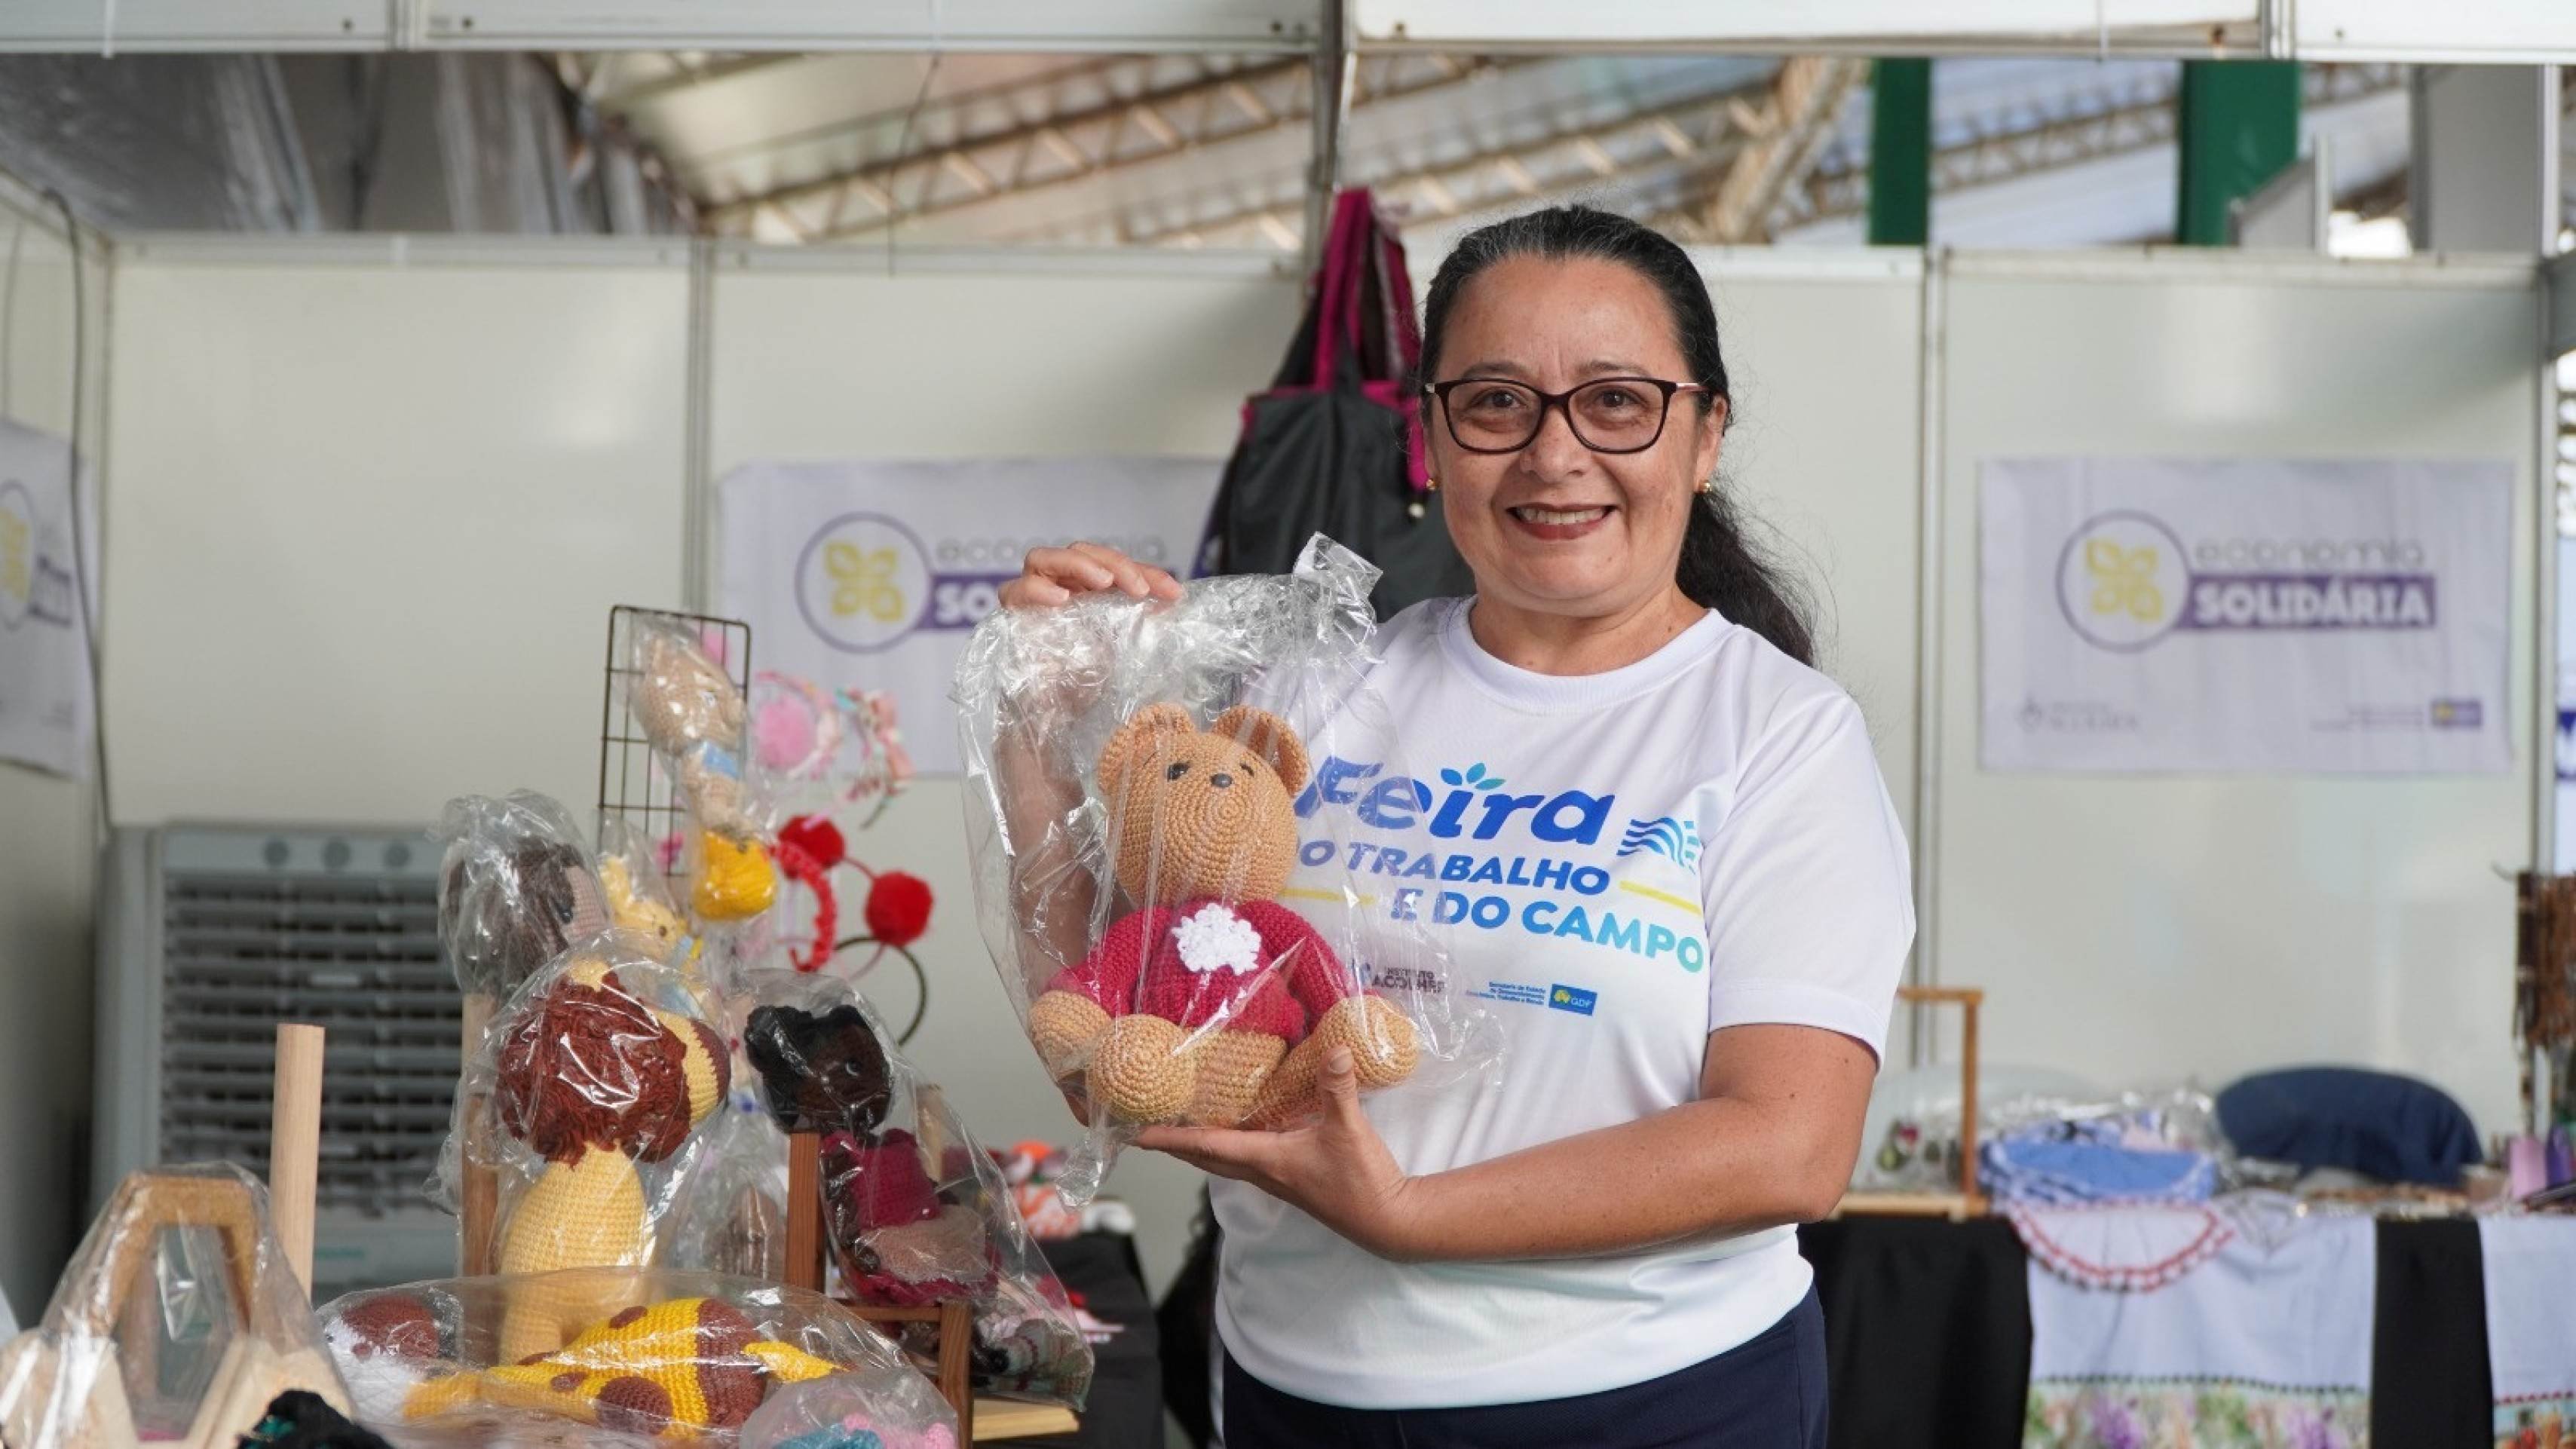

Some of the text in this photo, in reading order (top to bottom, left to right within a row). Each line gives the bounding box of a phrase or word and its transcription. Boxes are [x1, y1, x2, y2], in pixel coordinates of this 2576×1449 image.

[2195, 538, 2425, 566] economia
[2194, 574, 2429, 624] SOLIDÁRIA
[1294, 755, 1616, 845] Feira
[1297, 840, 1610, 896] O TRABALHO
[1390, 888, 1705, 973] E DO CAMPO
